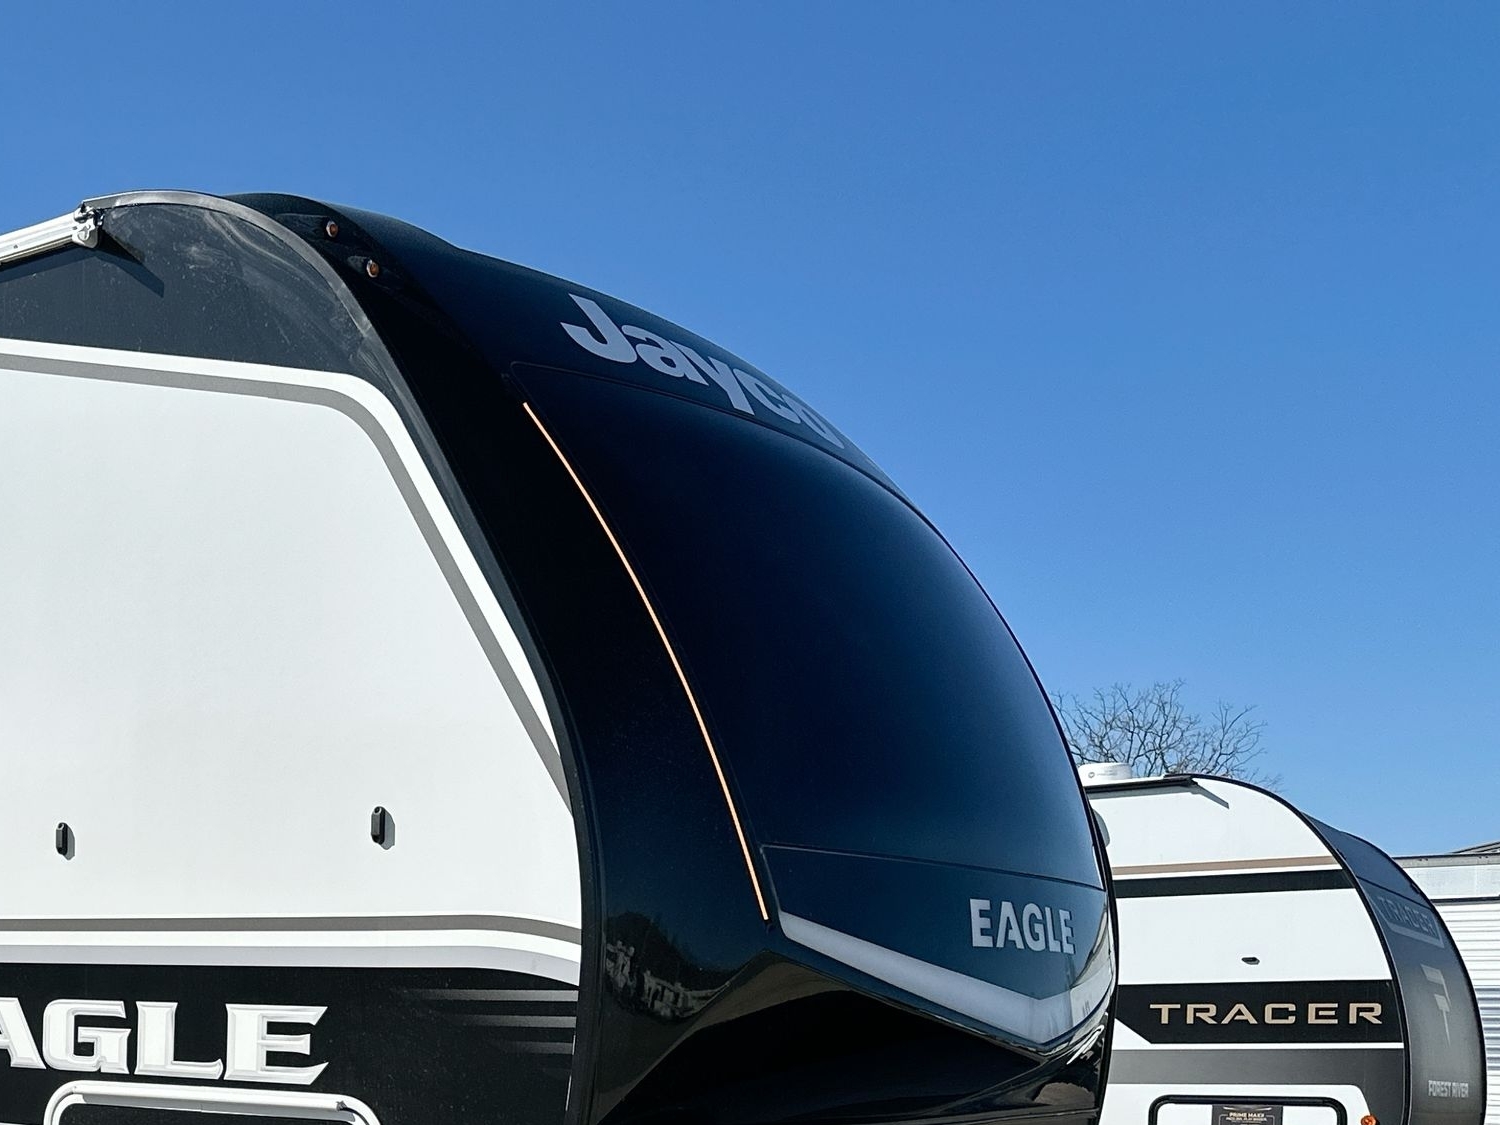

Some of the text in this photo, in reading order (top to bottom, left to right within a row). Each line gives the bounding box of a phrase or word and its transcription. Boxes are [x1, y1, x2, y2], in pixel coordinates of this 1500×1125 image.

[560, 293, 845, 449] Jayco
[969, 898, 1075, 955] EAGLE
[1150, 1003, 1382, 1025] TRACER
[1428, 1080, 1469, 1098] FOREST RIVER
